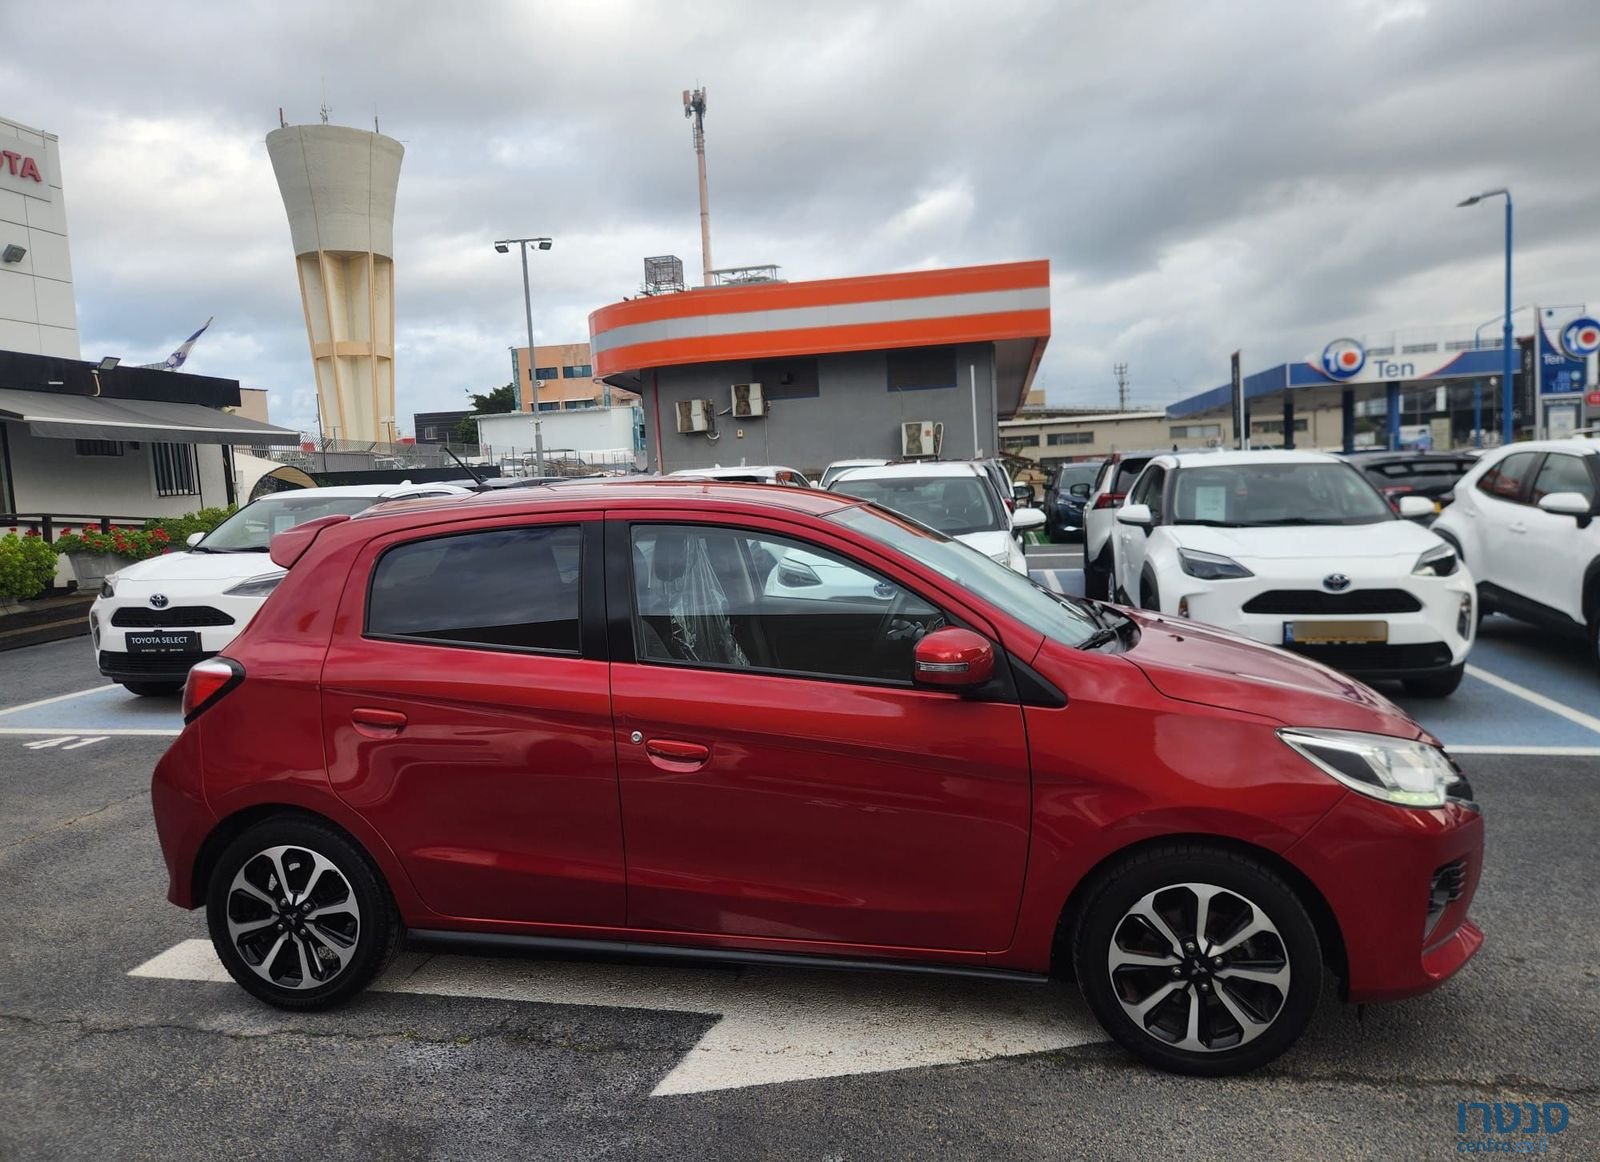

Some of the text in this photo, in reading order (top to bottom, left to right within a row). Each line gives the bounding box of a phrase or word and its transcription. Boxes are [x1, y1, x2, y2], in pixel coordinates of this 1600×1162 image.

[0, 150, 42, 182] TA
[1542, 353, 1566, 365] Ten
[1373, 359, 1415, 378] Ten
[131, 636, 188, 644] TOYOTA SELECT
